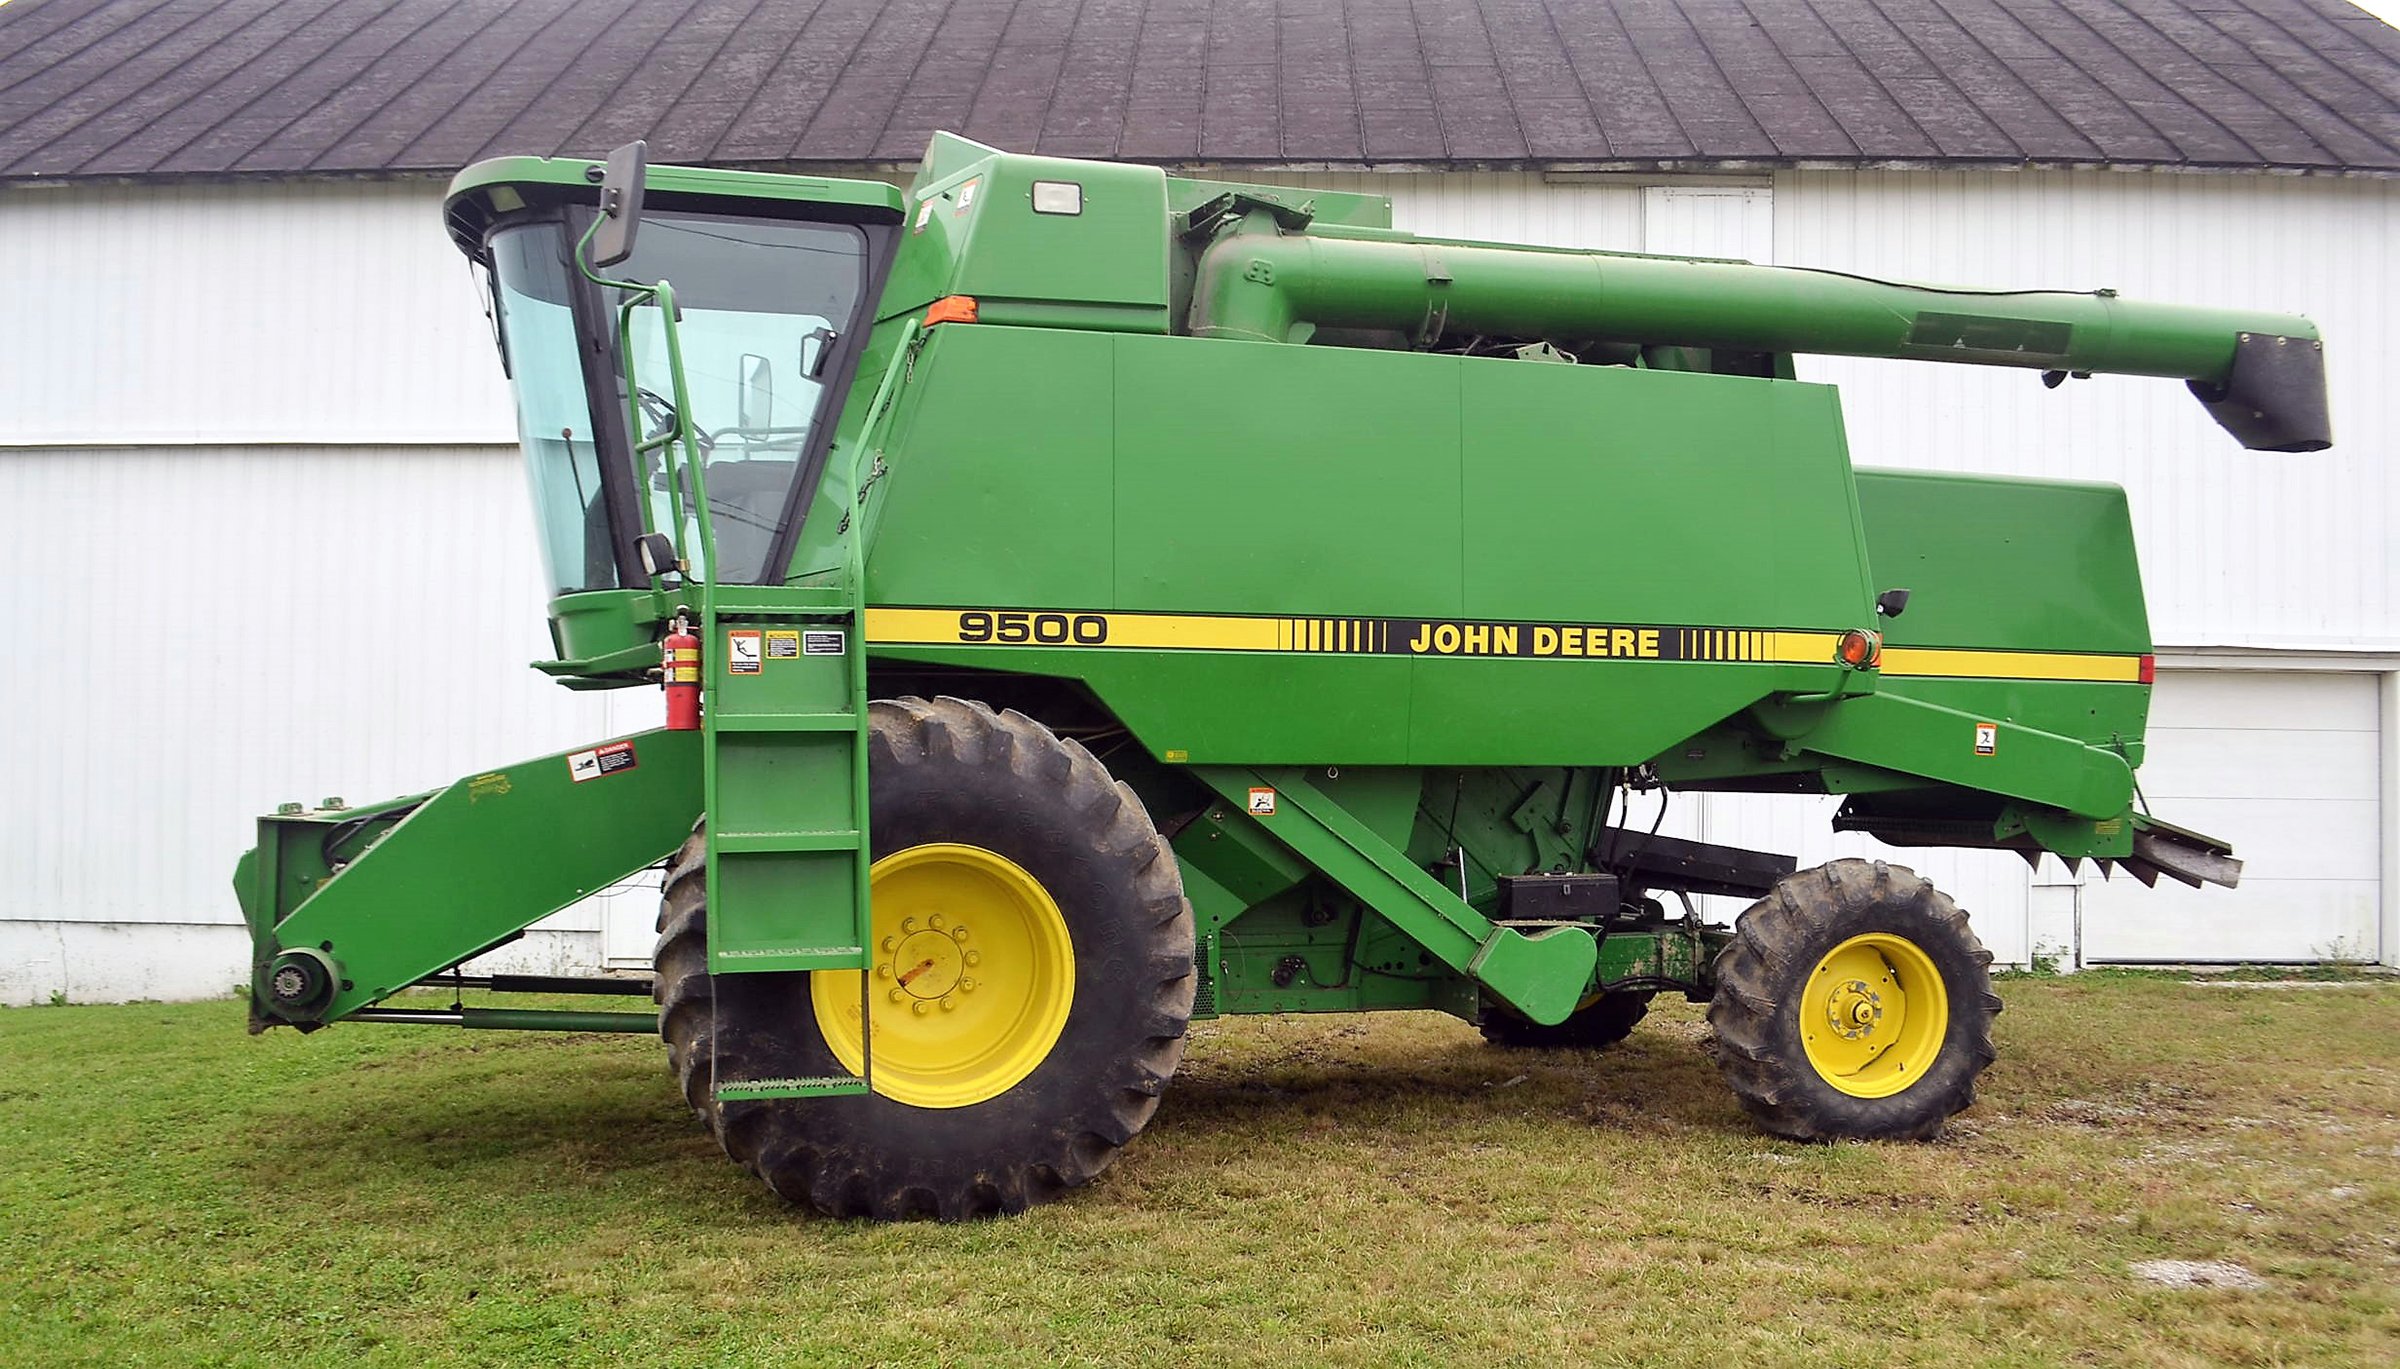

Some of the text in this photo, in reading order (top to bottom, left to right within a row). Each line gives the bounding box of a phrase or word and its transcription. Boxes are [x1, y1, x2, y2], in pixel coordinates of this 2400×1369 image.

[959, 612, 1108, 644] 9500
[1410, 623, 1660, 658] JOHN DEERE
